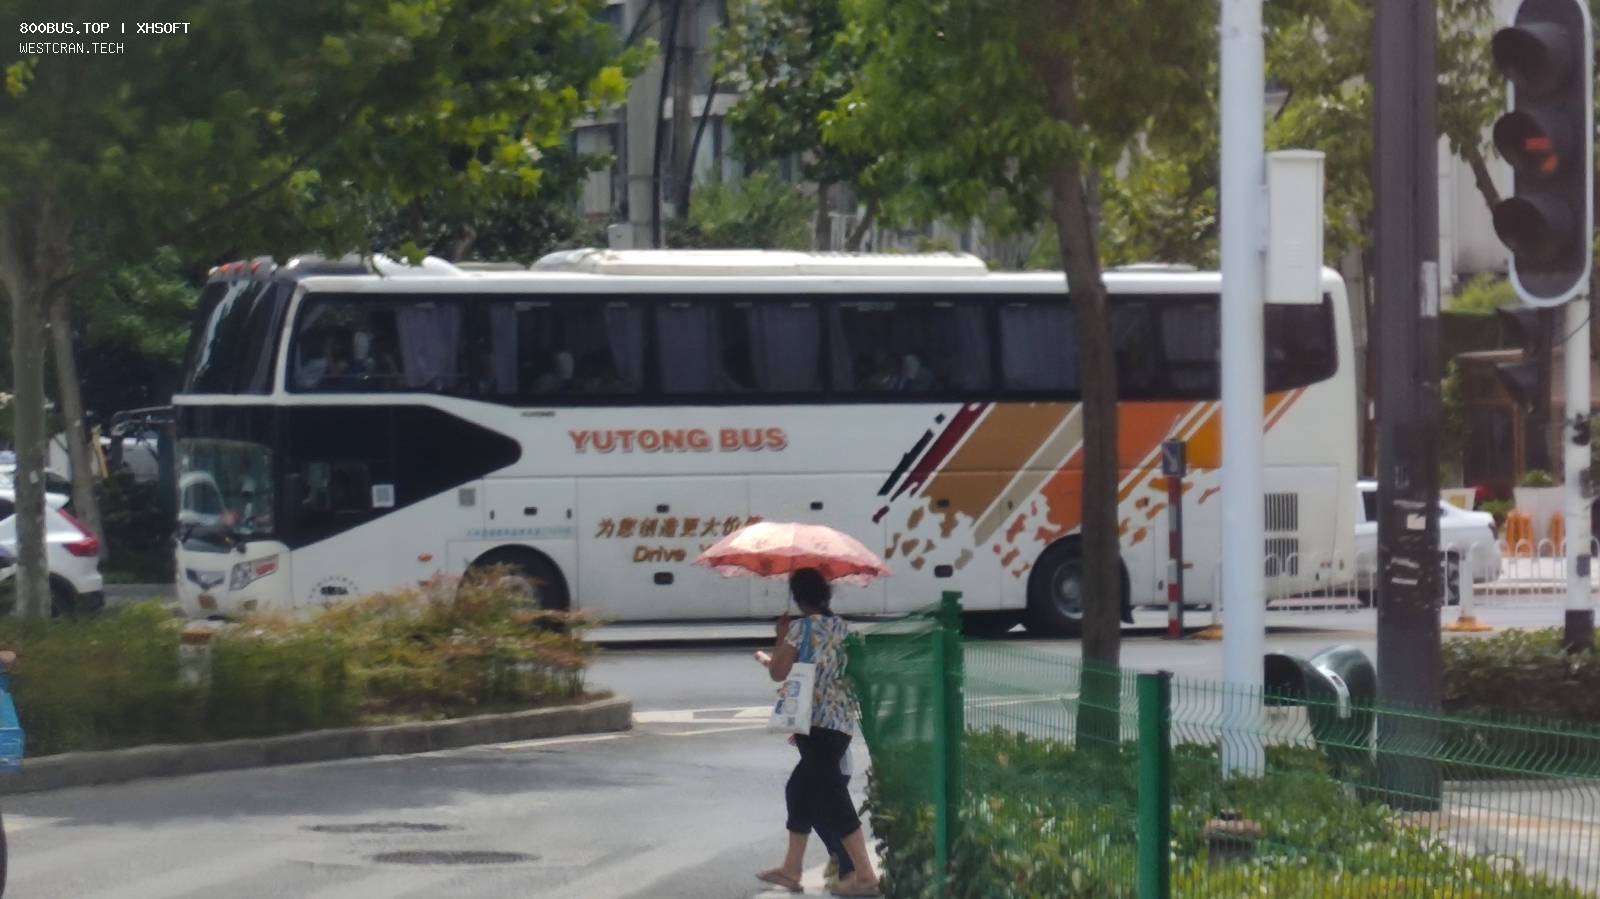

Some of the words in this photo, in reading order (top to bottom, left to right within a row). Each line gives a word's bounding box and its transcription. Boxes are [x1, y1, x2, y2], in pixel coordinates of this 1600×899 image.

[568, 429, 712, 454] YUTONG
[718, 426, 788, 451] BUS
[633, 544, 687, 563] Drive
